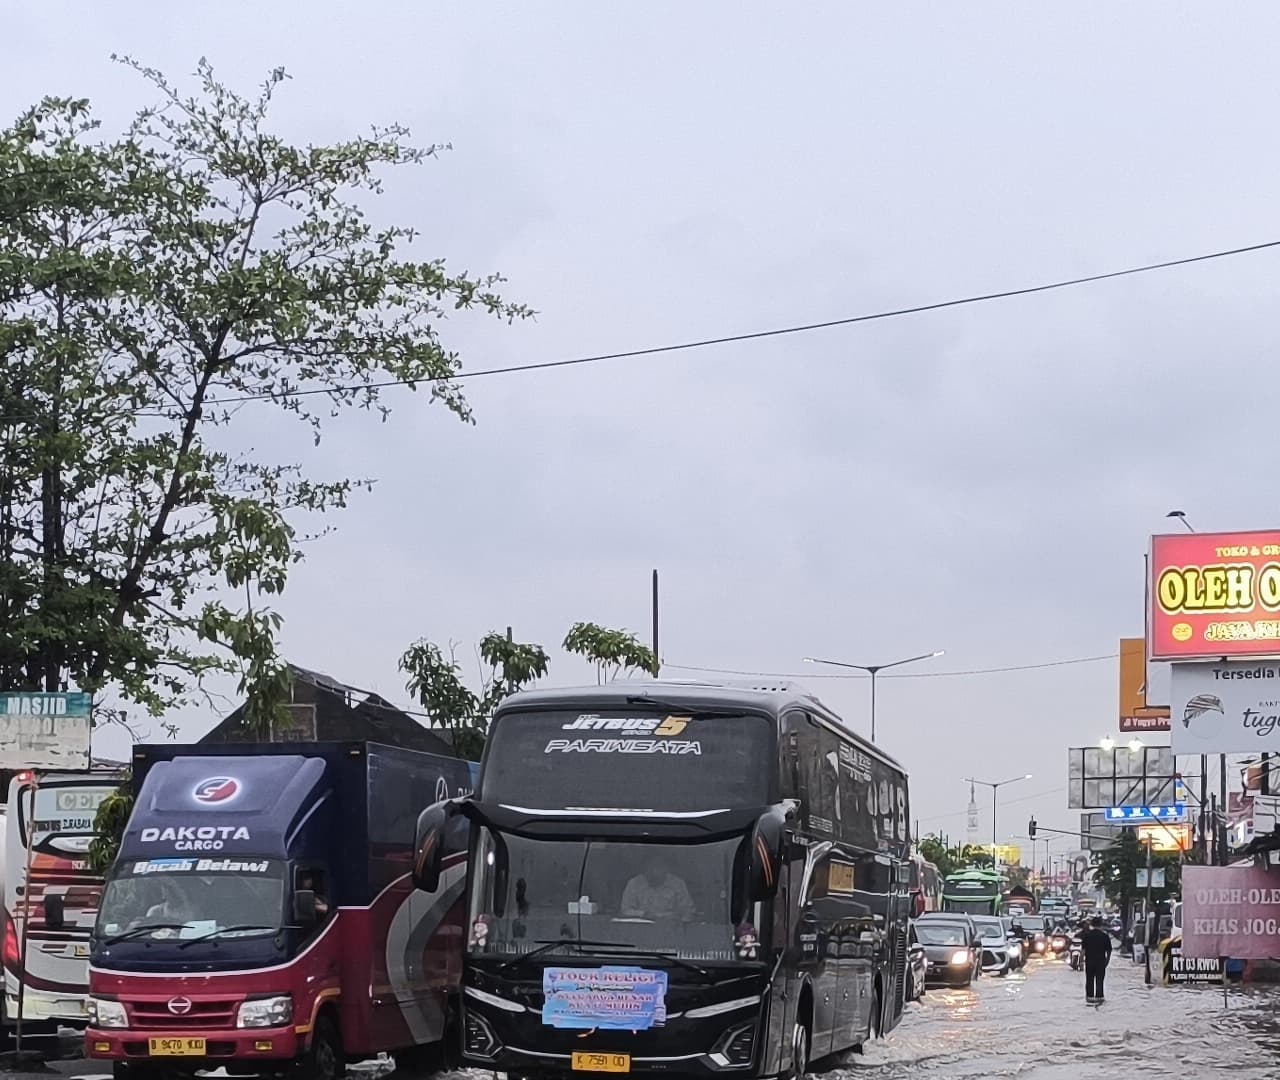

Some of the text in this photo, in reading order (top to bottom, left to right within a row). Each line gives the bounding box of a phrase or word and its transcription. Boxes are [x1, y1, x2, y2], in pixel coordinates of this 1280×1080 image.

[1215, 546, 1249, 558] TOKO
[1251, 546, 1261, 556] &
[1158, 565, 1255, 611] OLEH
[1213, 666, 1274, 680] Tersedia
[7, 697, 67, 715] MASJID
[545, 739, 702, 755] PARIWISATA
[140, 826, 251, 842] DAKOTA
[174, 840, 224, 851] CARGO
[196, 859, 269, 872] Betawi
[1193, 918, 1239, 935] KHAS
[1173, 957, 1184, 971] RT
[560, 972, 599, 981] TOUR
